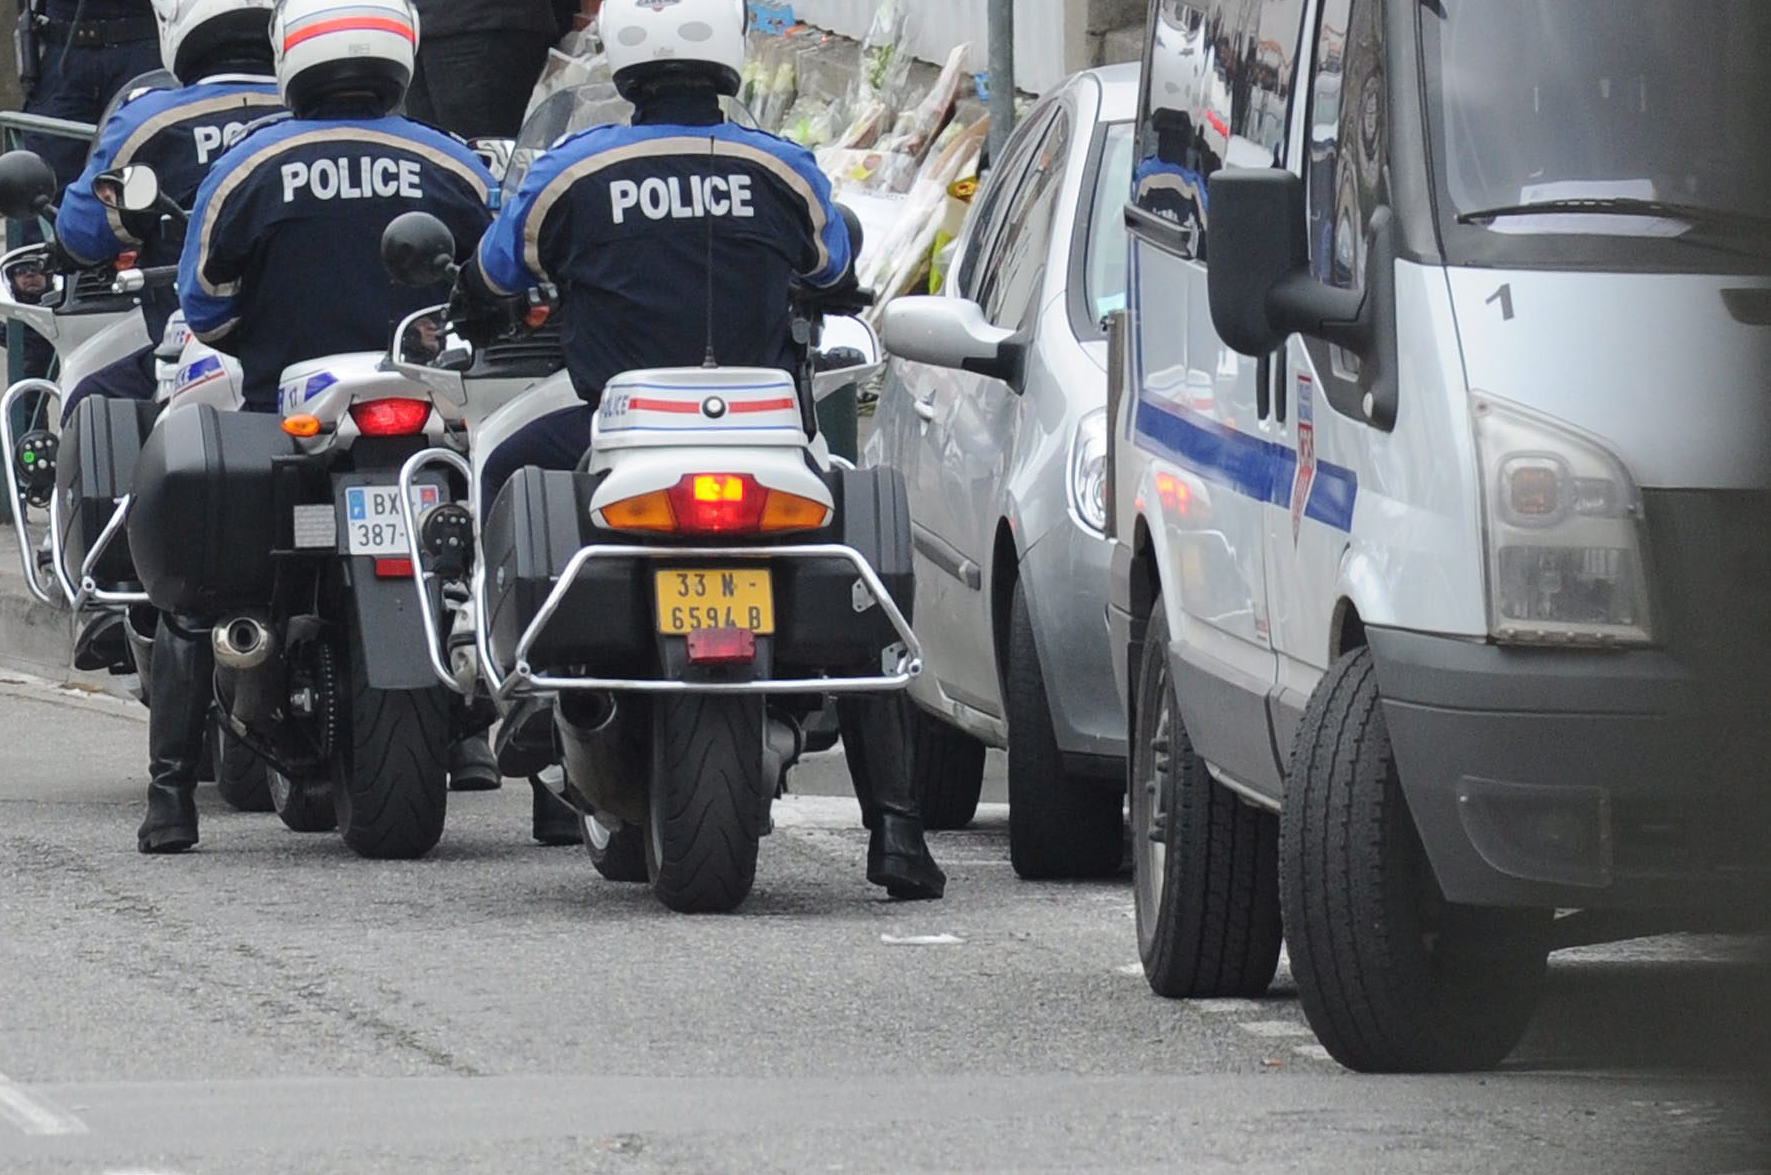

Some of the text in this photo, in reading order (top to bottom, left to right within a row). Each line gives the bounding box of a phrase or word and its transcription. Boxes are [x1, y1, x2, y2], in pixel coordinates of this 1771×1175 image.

[280, 156, 423, 203] POLICE
[609, 174, 755, 224] POLICE
[1485, 282, 1515, 321] 1
[676, 573, 707, 597] 33
[671, 606, 761, 629] 6594 B
